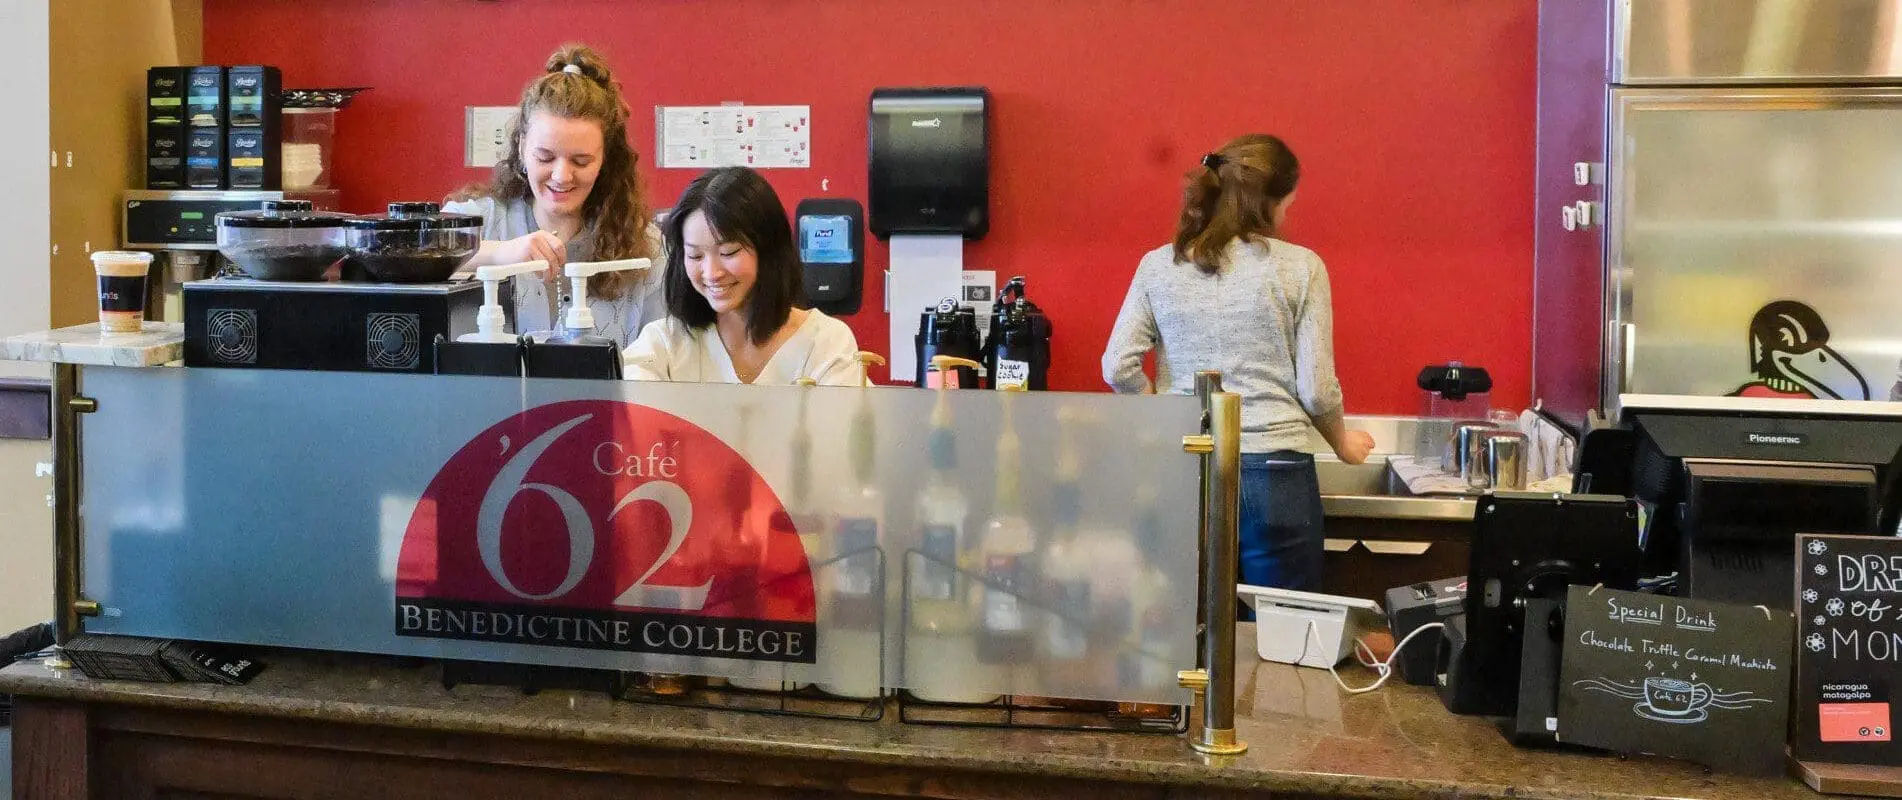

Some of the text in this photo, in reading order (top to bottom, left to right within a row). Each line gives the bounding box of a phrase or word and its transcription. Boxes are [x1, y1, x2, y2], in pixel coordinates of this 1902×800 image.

[592, 440, 678, 477] Café
[1608, 598, 1717, 628] Special Drink
[1851, 599, 1892, 622] of
[400, 604, 804, 657] BENEDICTINE COLLEGE
[1580, 631, 1635, 652] Chocolate
[1641, 640, 1680, 657] Truffle
[1823, 683, 1868, 691] nicaragua
[1823, 691, 1871, 700] matagalpa
